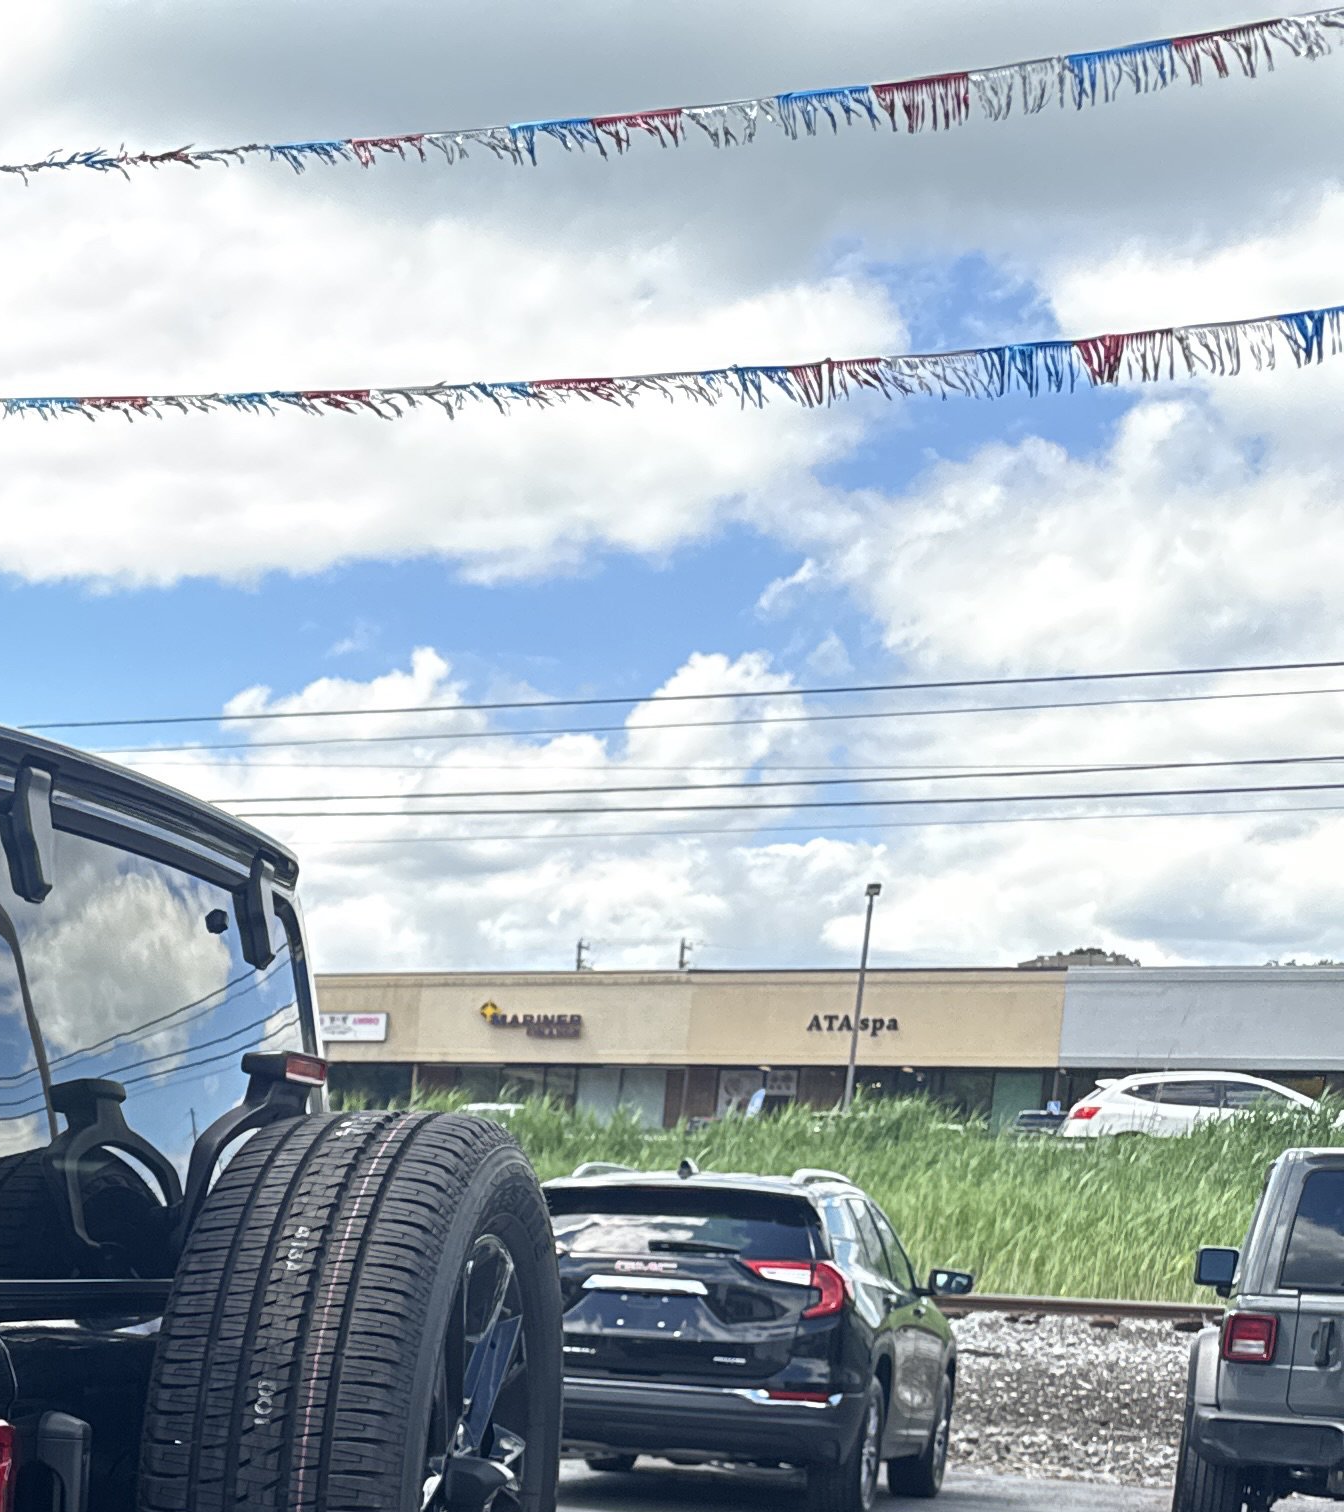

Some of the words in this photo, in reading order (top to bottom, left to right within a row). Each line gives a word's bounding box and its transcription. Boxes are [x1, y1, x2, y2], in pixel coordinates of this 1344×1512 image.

[492, 1014, 582, 1027] MARINER
[806, 1013, 853, 1032] ATA
[859, 1016, 899, 1038] spa
[614, 1259, 677, 1273] GMC
